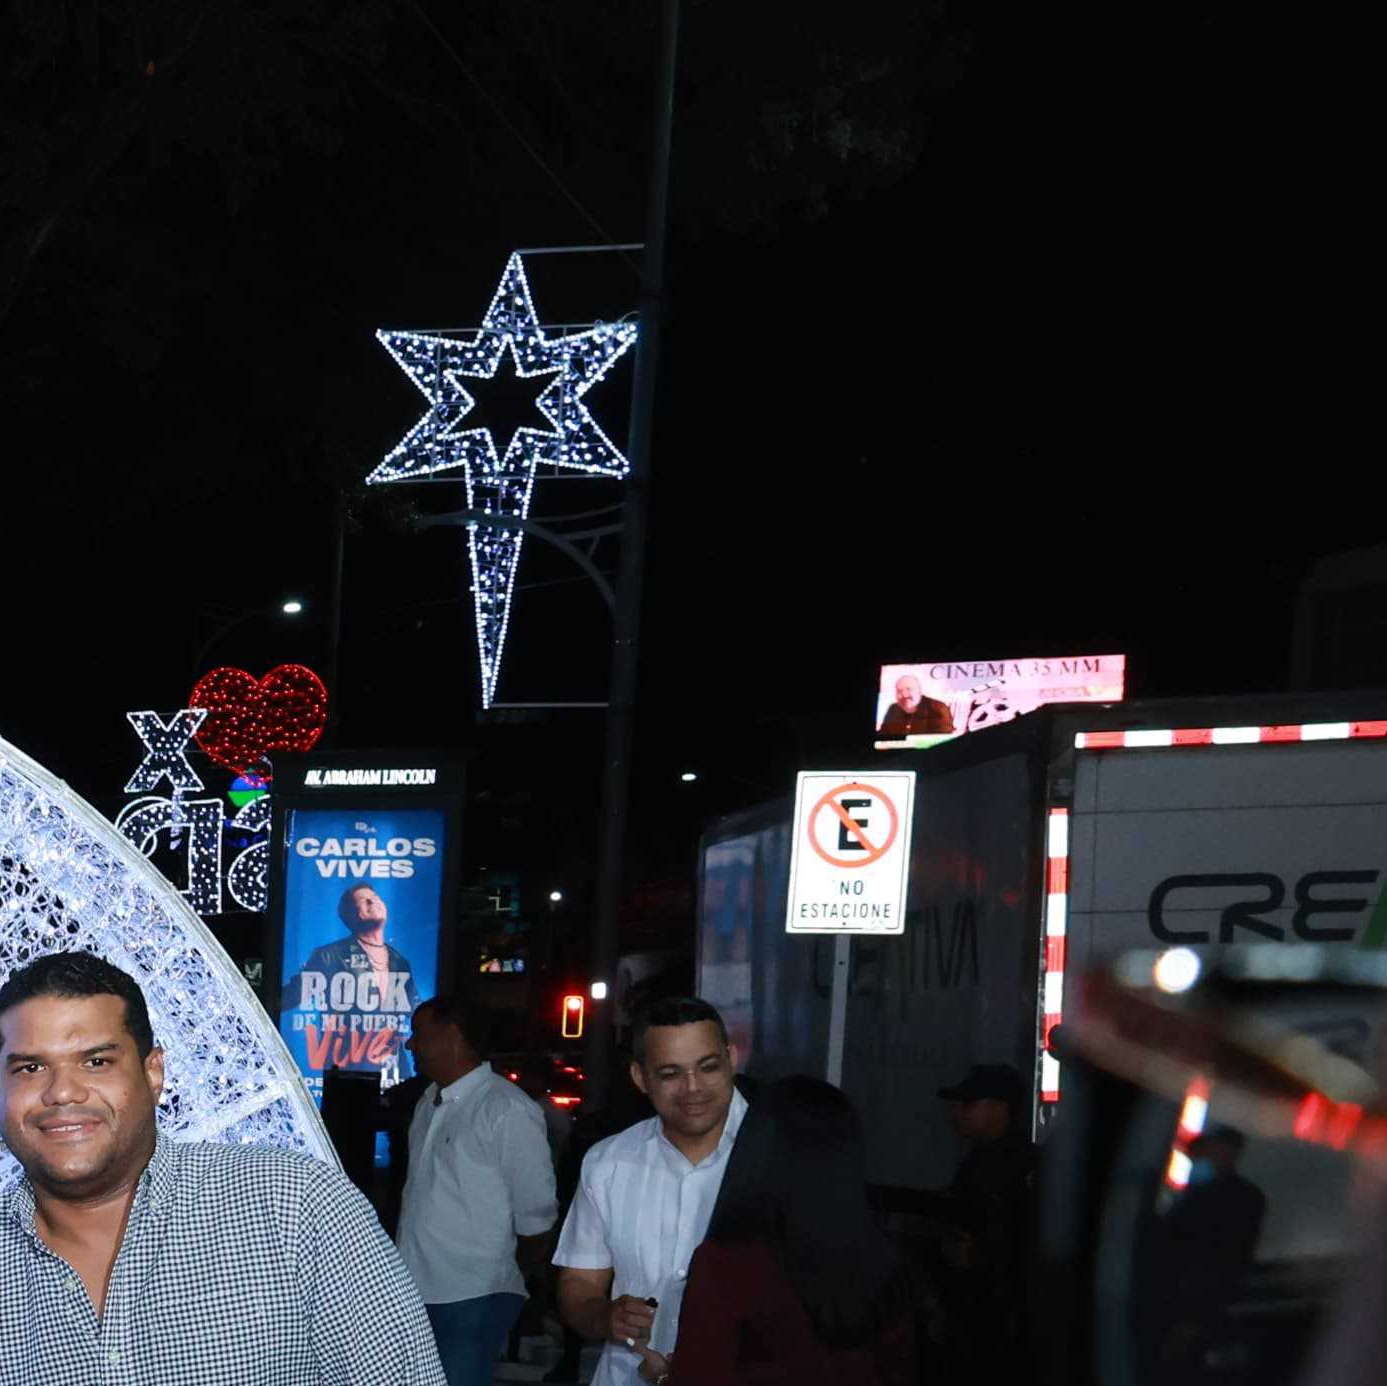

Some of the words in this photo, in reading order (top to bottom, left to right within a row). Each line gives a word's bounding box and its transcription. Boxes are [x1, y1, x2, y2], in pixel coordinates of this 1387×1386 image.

[929, 661, 1021, 680] CINEMA
[1059, 658, 1100, 676] MM
[322, 769, 381, 785] ABRAHAM
[382, 769, 436, 785] LINCOLN
[296, 837, 436, 858] CARLOS
[315, 859, 415, 879] VIVES
[839, 879, 865, 896] NO
[800, 903, 892, 919] ESTACIONE
[299, 971, 412, 1012] ROCK
[292, 1013, 316, 1031] DE
[321, 1013, 346, 1032] MI
[350, 1013, 412, 1032] PUEBL
